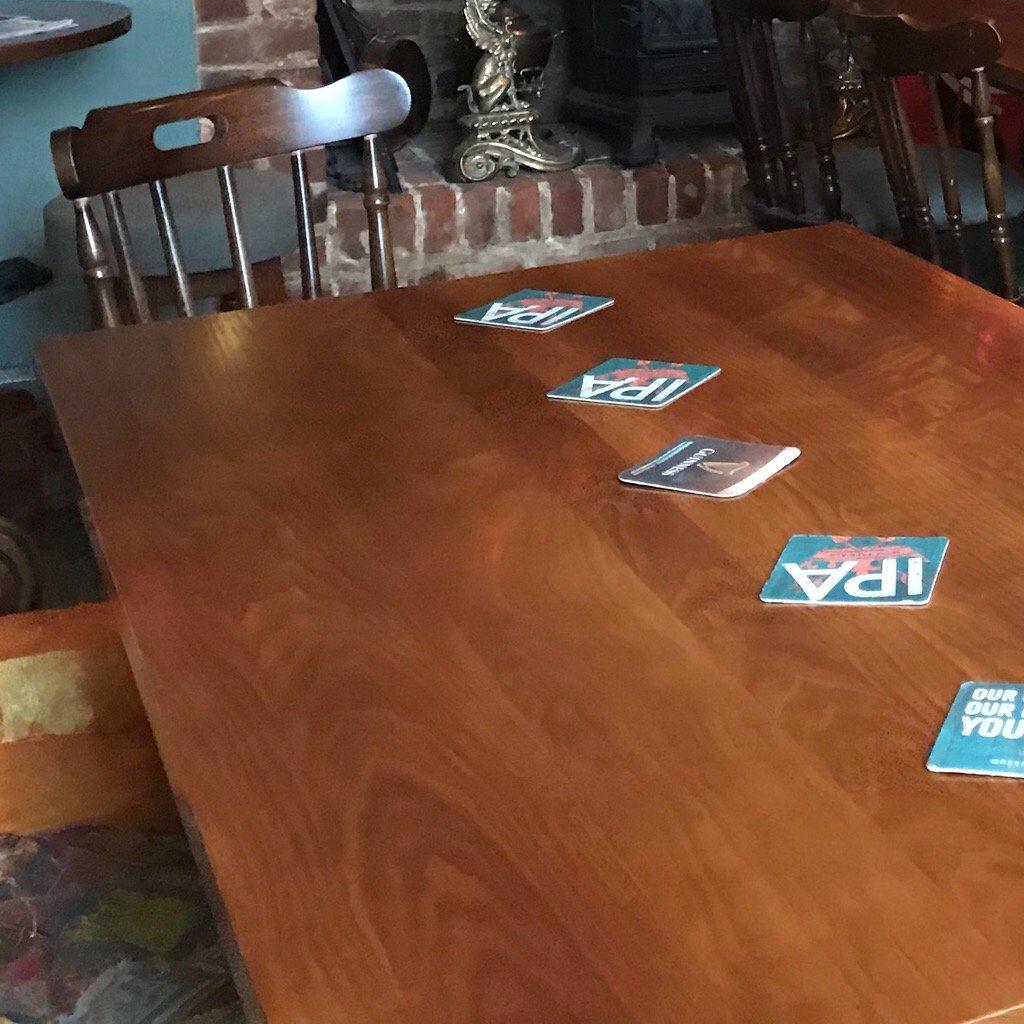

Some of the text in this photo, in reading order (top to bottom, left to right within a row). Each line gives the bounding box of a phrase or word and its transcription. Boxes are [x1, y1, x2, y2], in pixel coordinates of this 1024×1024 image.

[481, 302, 580, 326] IPA
[579, 374, 688, 402] IPA
[782, 556, 923, 601] IPA
[972, 688, 1018, 702] OUR
[964, 701, 1014, 717] OUR
